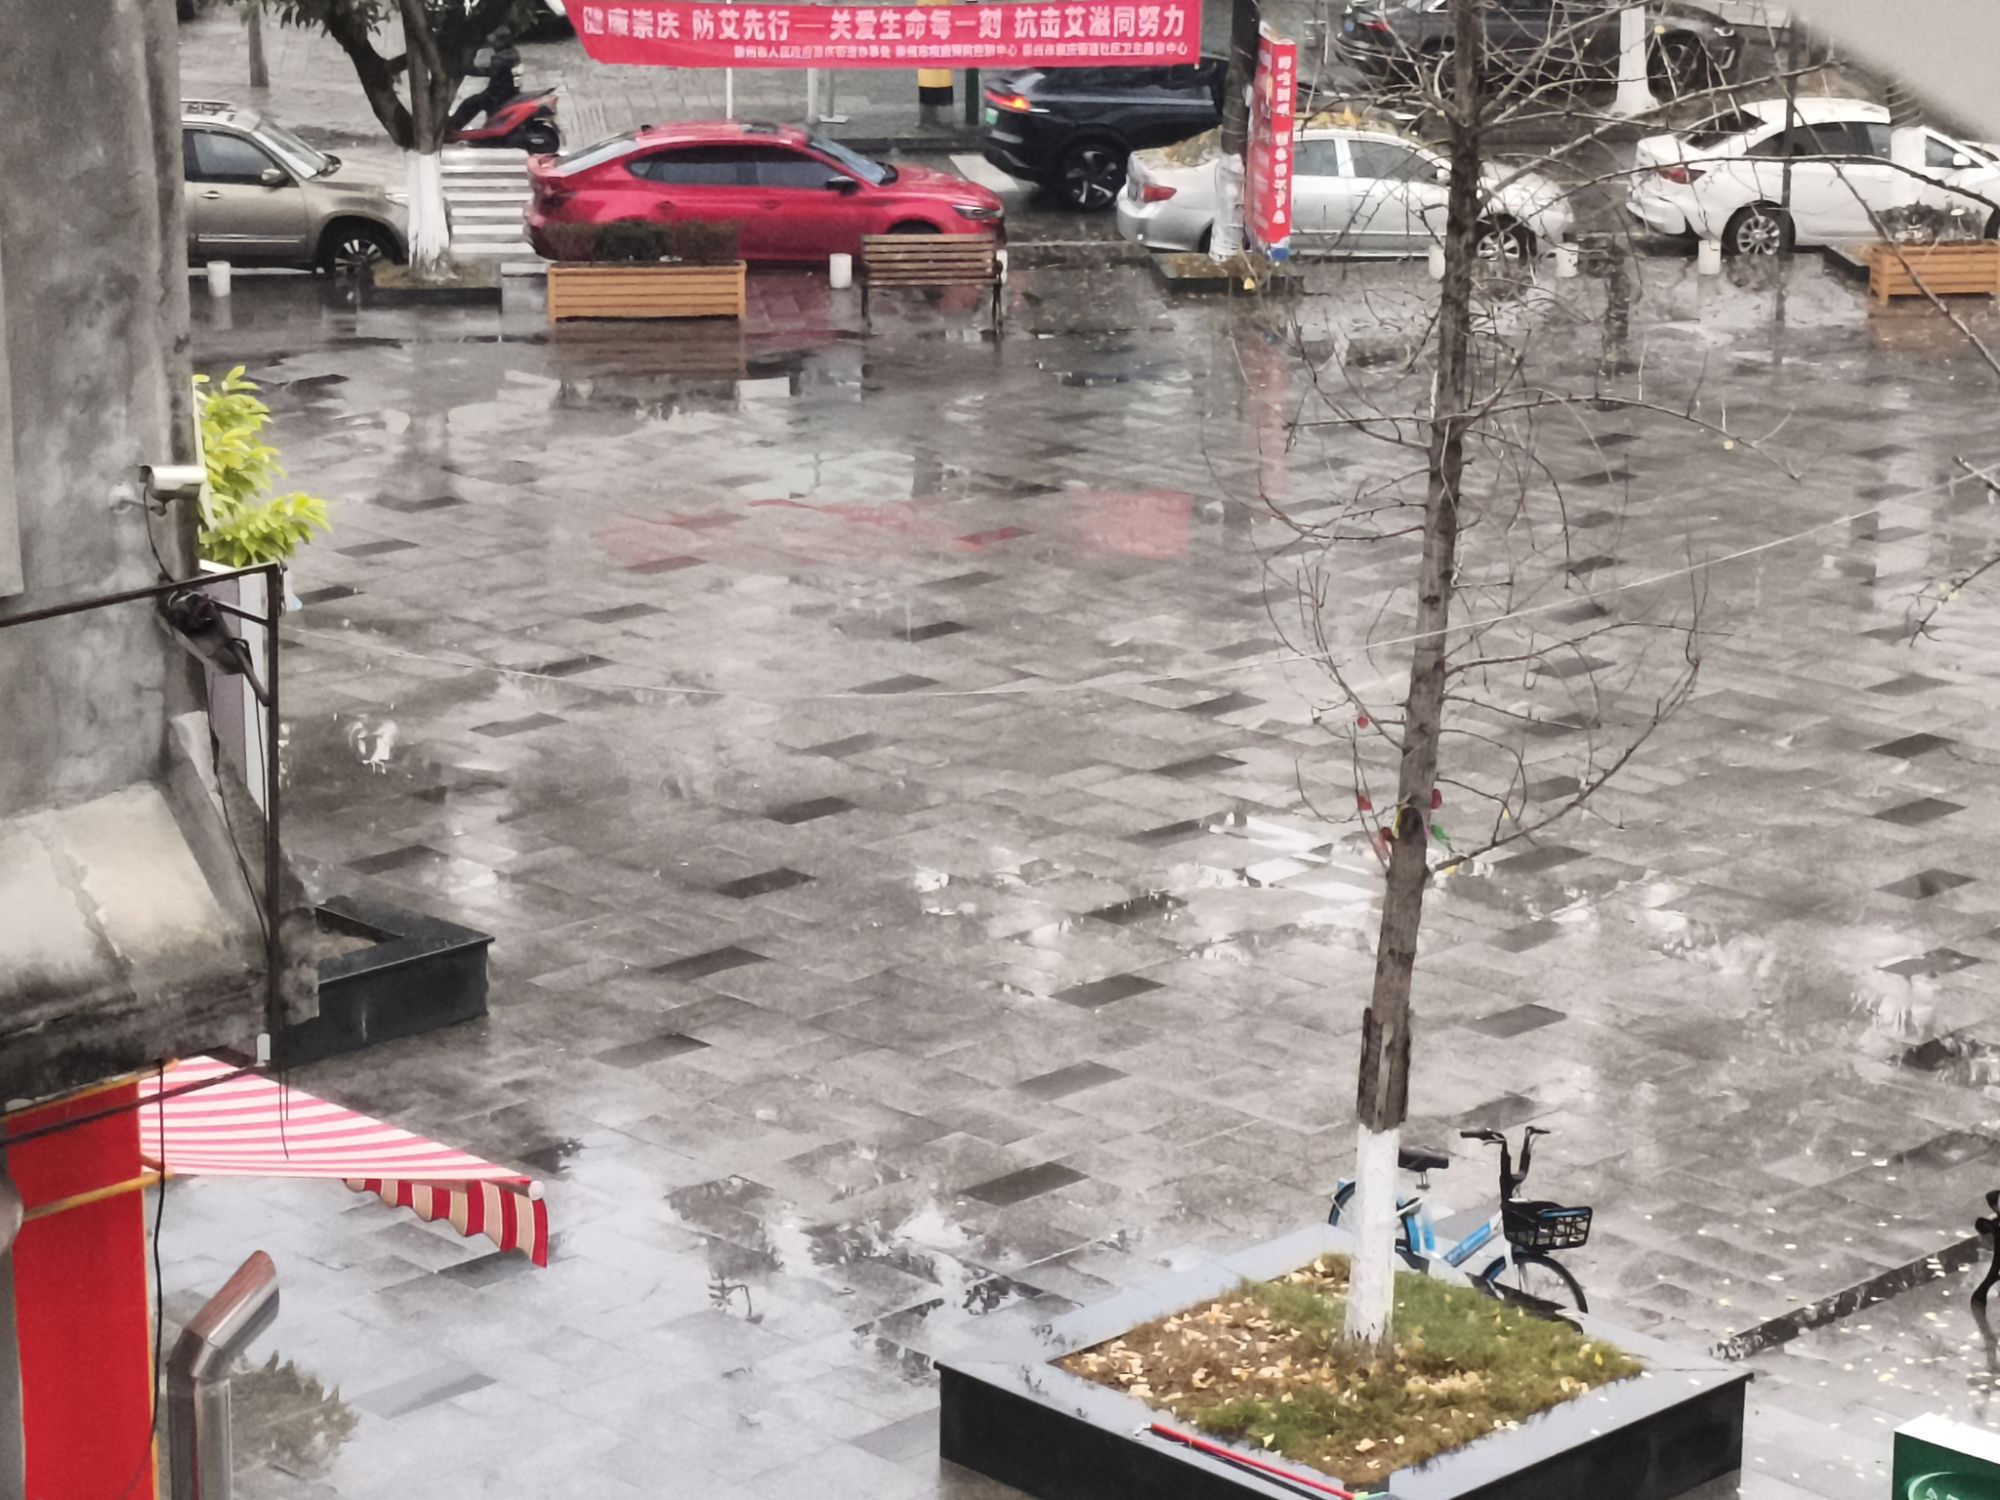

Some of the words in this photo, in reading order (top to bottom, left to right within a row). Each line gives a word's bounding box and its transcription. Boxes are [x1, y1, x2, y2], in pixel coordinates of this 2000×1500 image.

[1014, 4, 1185, 39] 抗击艾滋同努力
